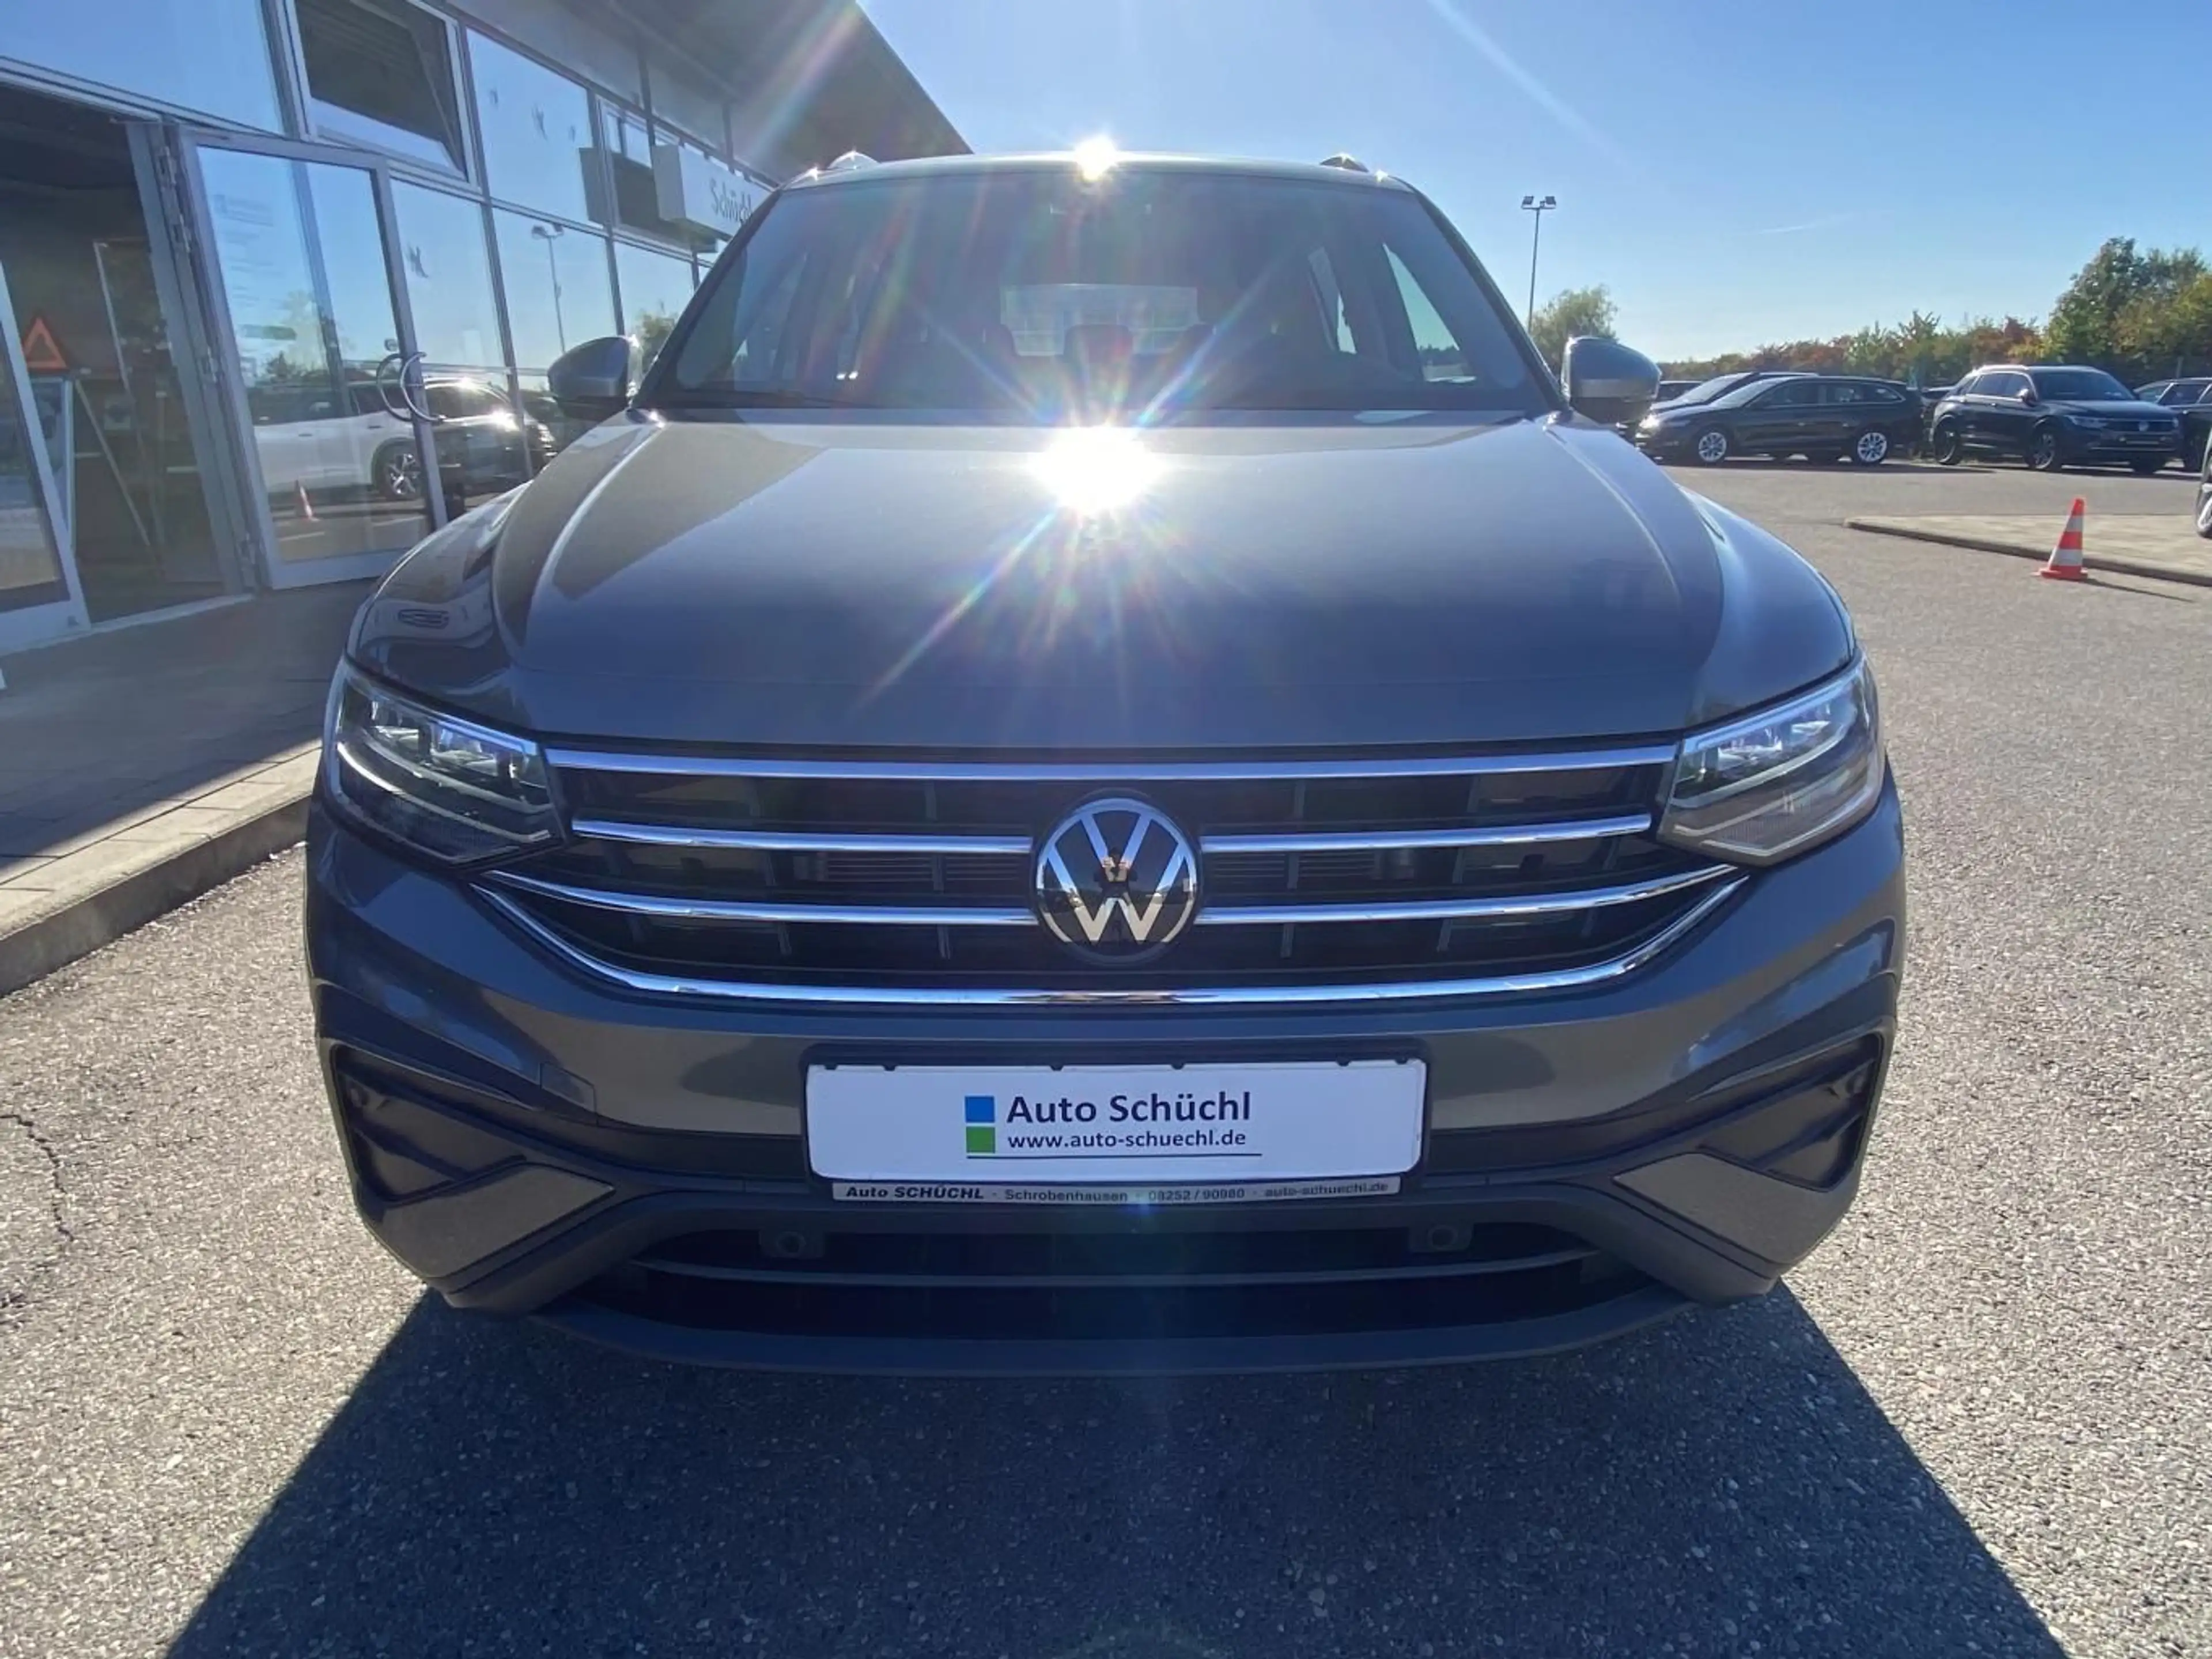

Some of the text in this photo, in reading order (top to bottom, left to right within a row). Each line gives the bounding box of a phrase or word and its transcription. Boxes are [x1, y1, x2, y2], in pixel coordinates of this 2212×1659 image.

[1007, 1091, 1251, 1123] Auto Schüchl
[1008, 1128, 1246, 1148] www.auto-schuechl.de
[846, 1186, 888, 1198] Auto
[894, 1184, 984, 1199] SCHÜCHL
[1005, 1188, 1128, 1202] Schrobenhausen
[1265, 1182, 1389, 1197] auto-schuechl.de
